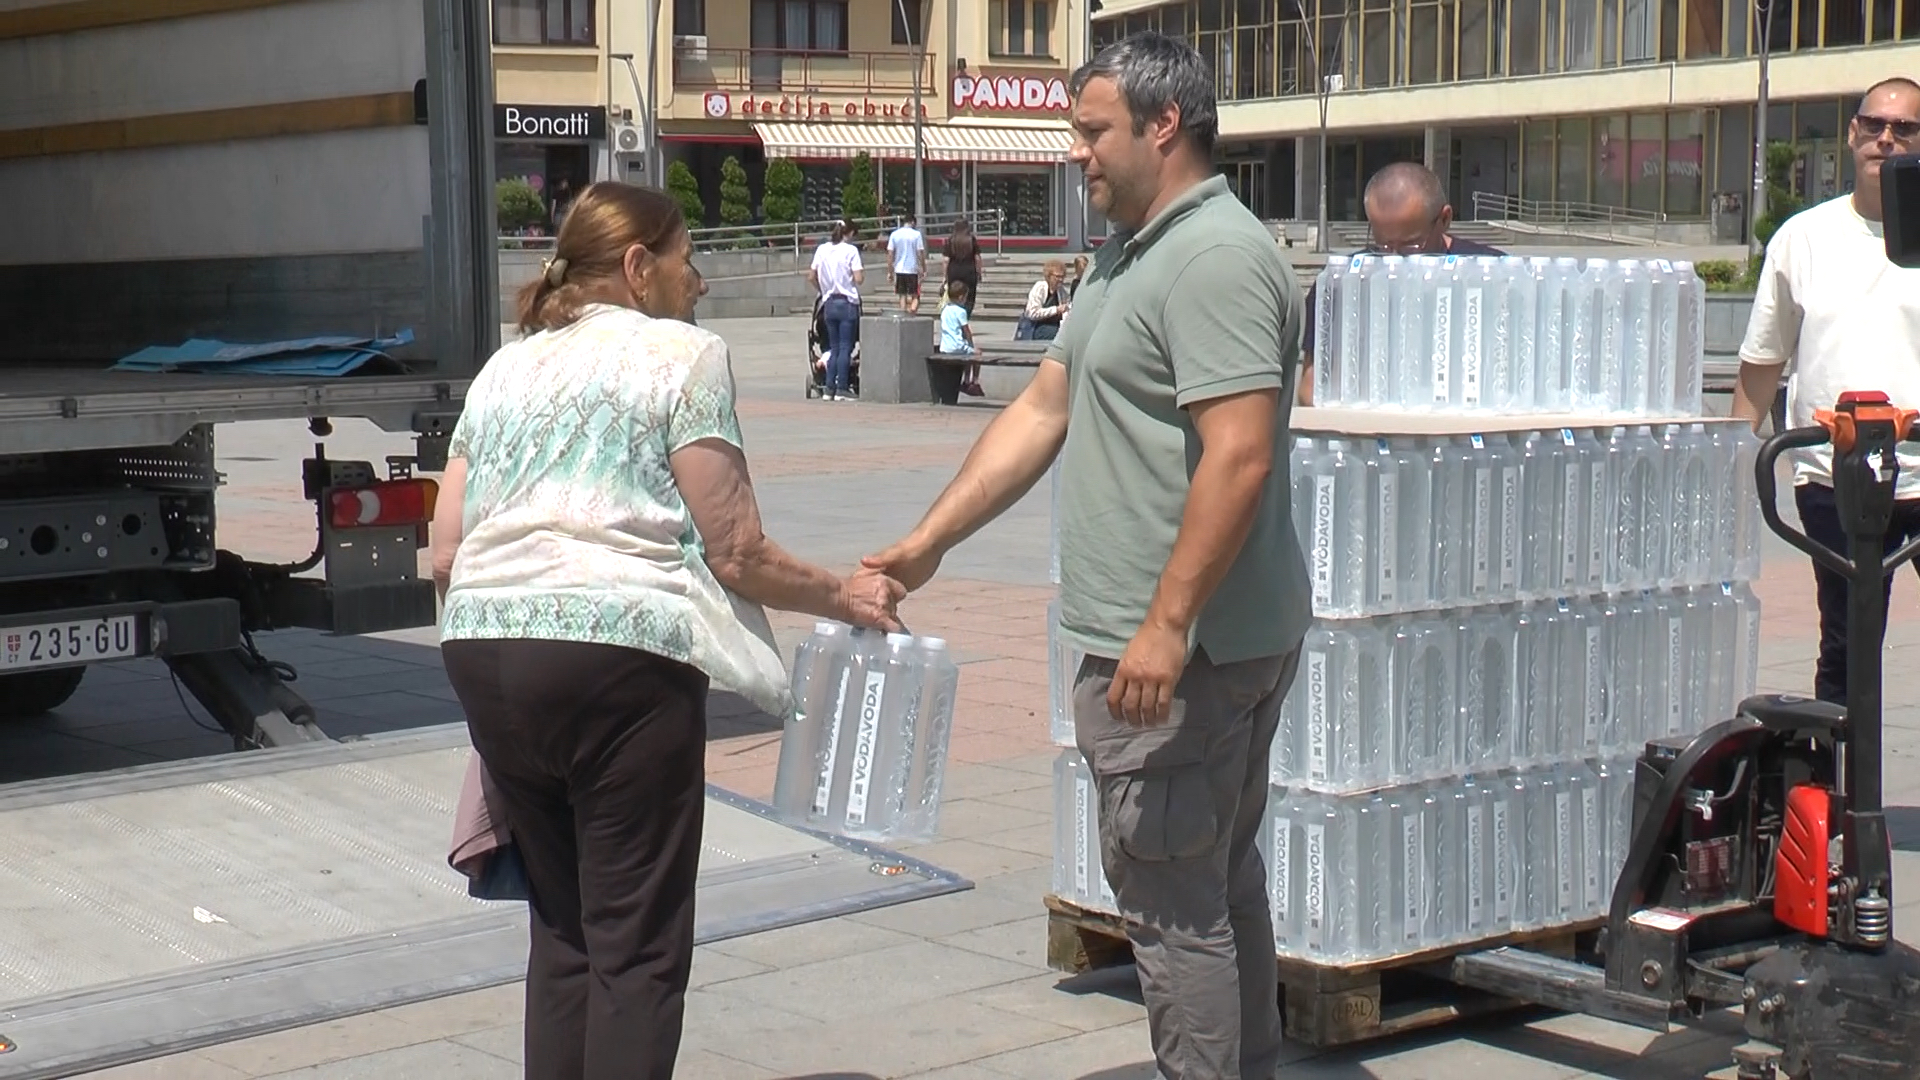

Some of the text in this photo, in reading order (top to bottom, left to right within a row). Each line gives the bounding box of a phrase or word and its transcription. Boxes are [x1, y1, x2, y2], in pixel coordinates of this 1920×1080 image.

[506, 107, 589, 136] Bonatti
[741, 93, 927, 119] dečija obuća
[953, 75, 1071, 110] PANDA
[1437, 295, 1448, 372] VODAVODA
[1468, 295, 1478, 373] VODAVODA
[1318, 484, 1330, 569] VODAVODA
[1505, 475, 1515, 558] VODAVODA
[855, 682, 879, 783] VODAVODA
[1311, 661, 1323, 745] VODAVODA
[1077, 787, 1085, 864] VODAVODA
[1408, 823, 1417, 907] VODAVODA
[1472, 815, 1481, 896] VODAVODA
[1497, 809, 1506, 893] VODAVODA
[1276, 827, 1287, 909] VODAVODA
[1310, 833, 1321, 916] VODAVODA
